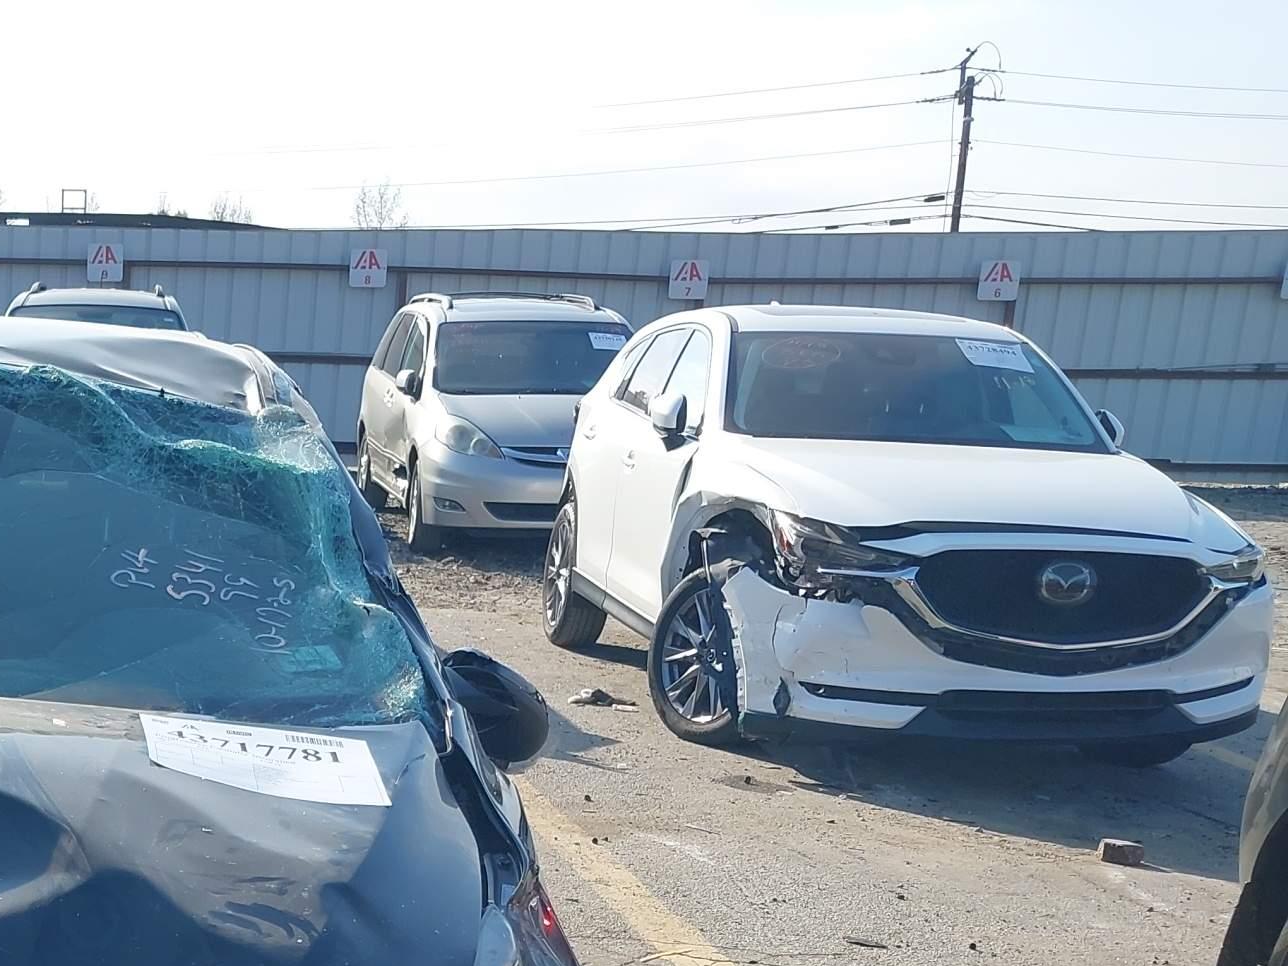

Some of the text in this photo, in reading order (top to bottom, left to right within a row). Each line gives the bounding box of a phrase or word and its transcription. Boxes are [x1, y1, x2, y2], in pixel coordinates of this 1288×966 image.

[685, 287, 692, 297] 7
[994, 288, 1001, 298] 6
[166, 548, 224, 605] 5341
[165, 729, 342, 764] 43717781
